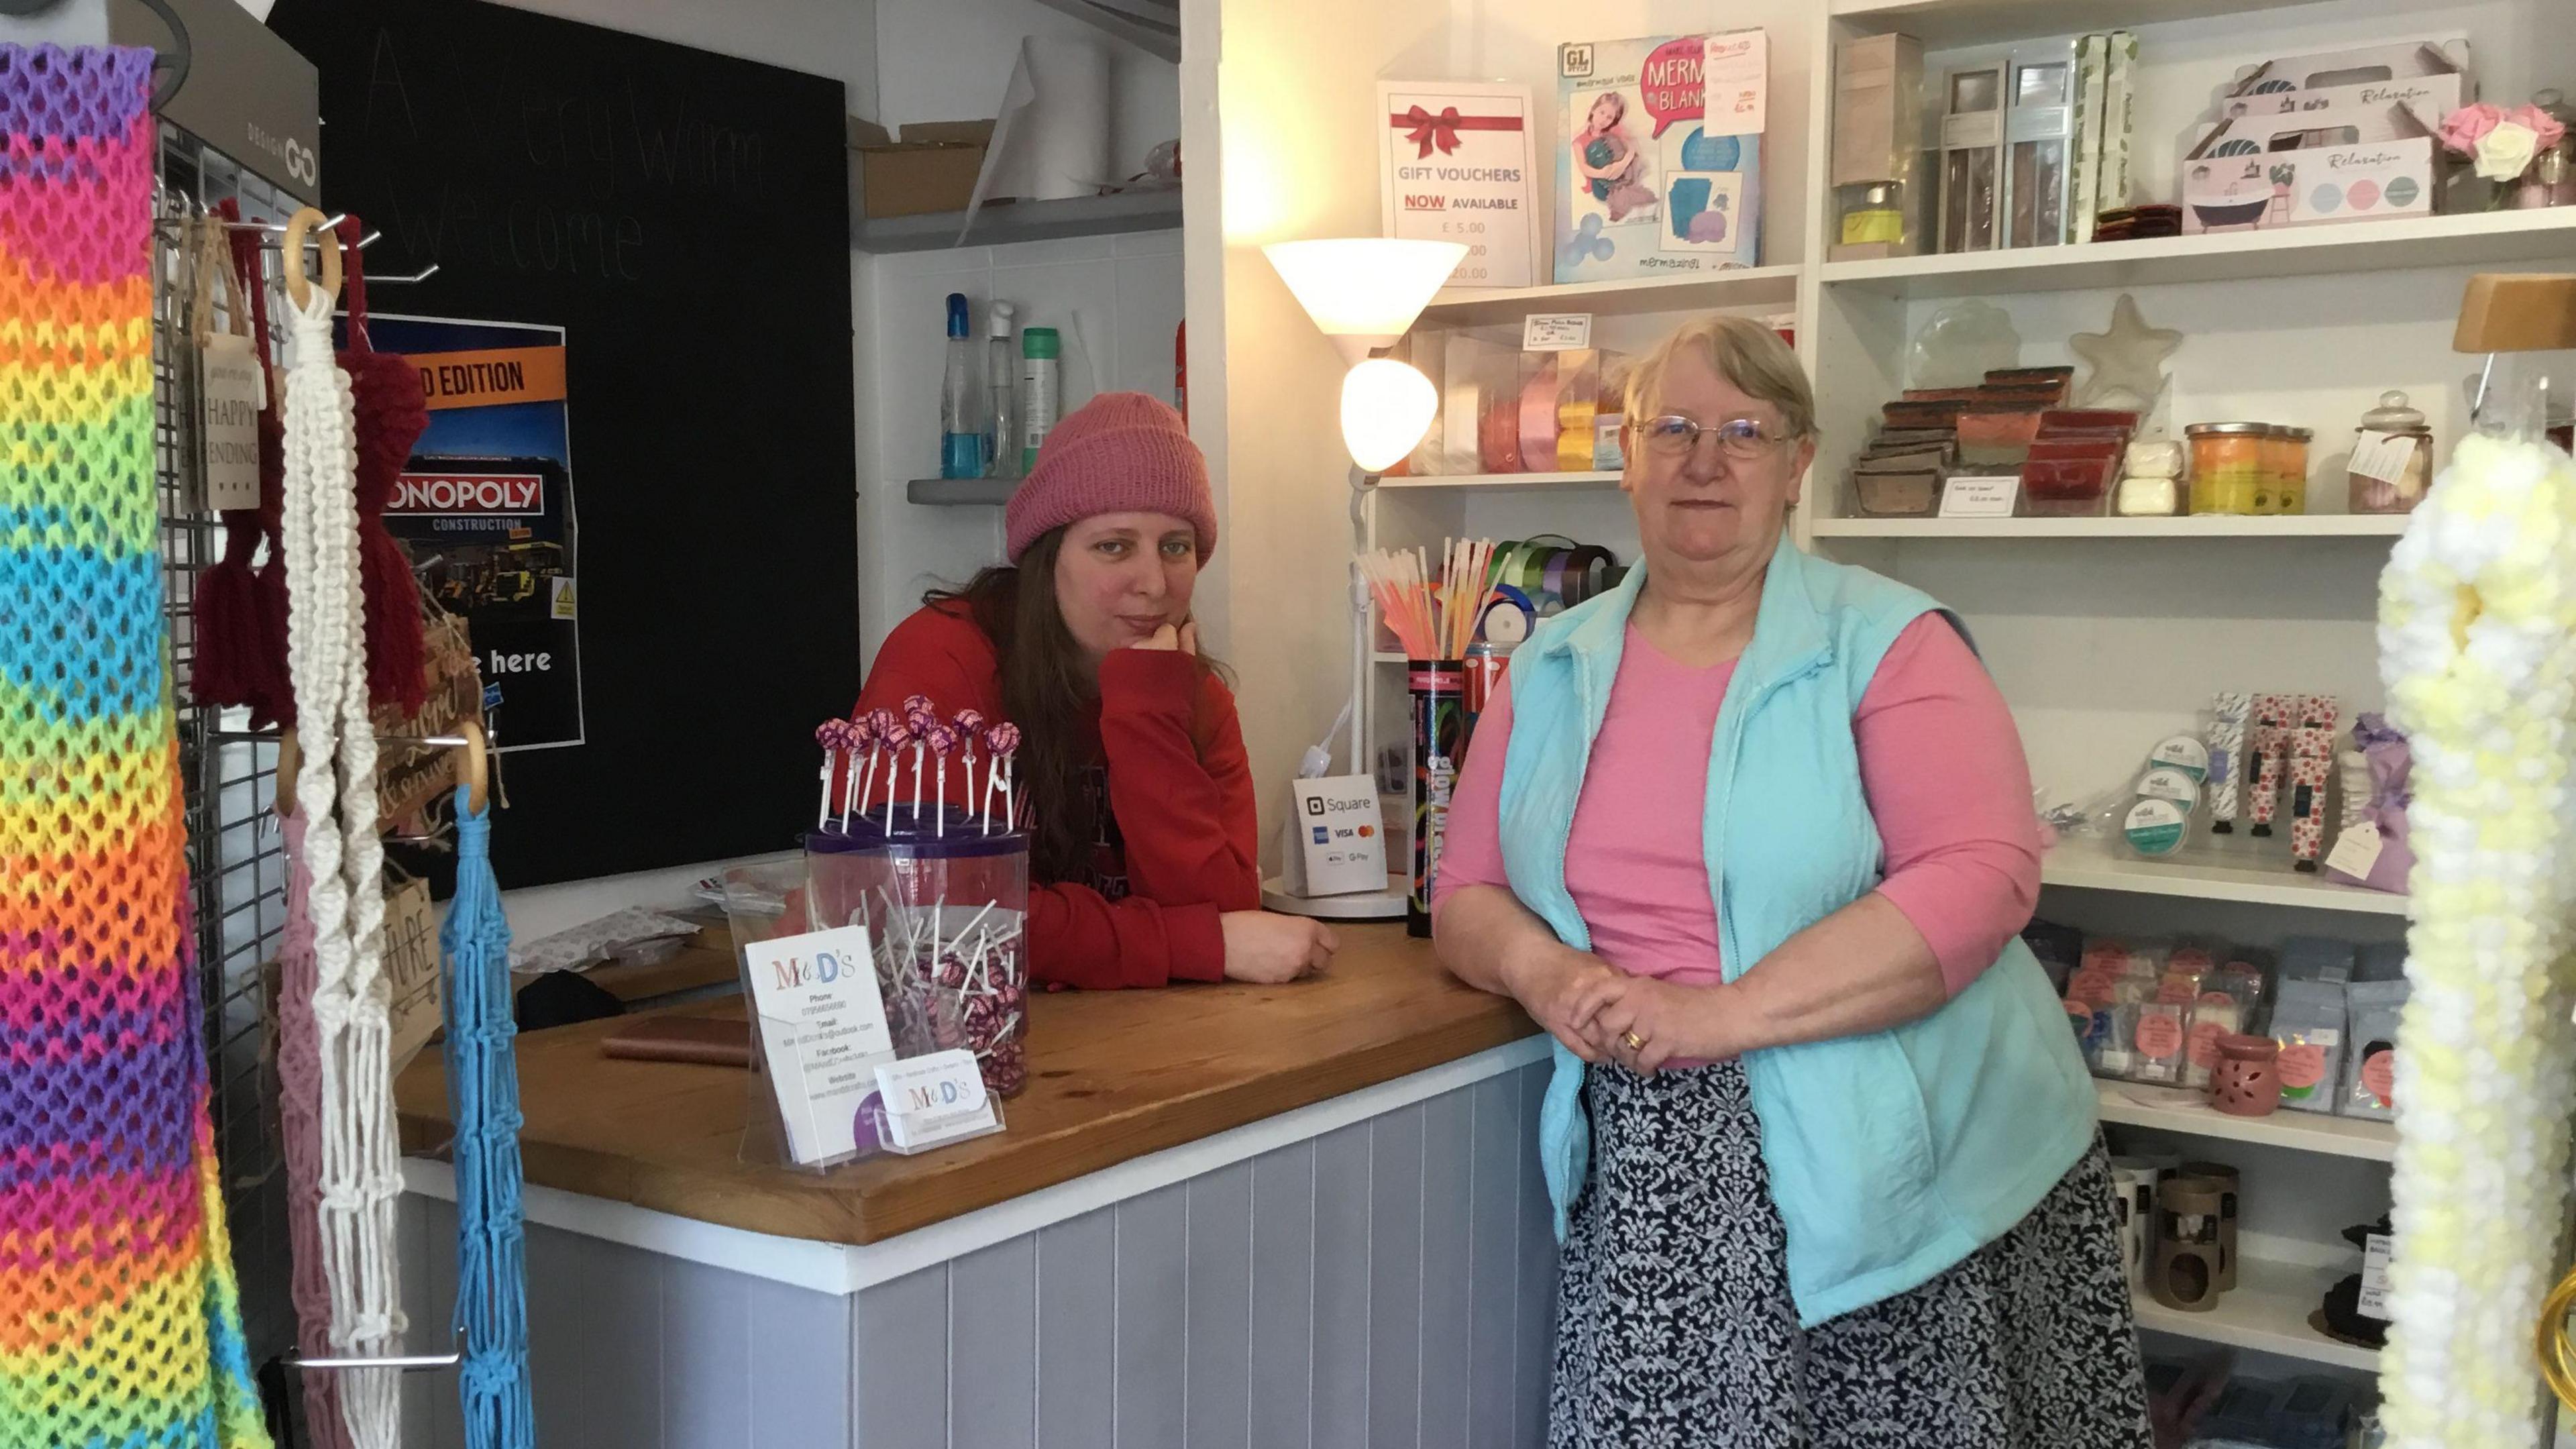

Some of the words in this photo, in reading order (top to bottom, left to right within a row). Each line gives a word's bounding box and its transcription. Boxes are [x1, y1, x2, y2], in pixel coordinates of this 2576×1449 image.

[1566, 50, 1589, 66] GL
[1648, 58, 1705, 87] MERM
[2360, 88, 2430, 104] Relaxation
[285, 138, 316, 187] GO
[2328, 152, 2402, 169] Relaxation
[1399, 166, 1433, 180] GIFT
[1436, 167, 1521, 182] VOUCHERS
[1405, 195, 1446, 211] NOW
[1452, 198, 1519, 210] AVAILABLE
[1456, 222, 1486, 234] 5.00
[439, 362, 525, 396] EDITION
[207, 398, 256, 427] HAPPY
[209, 441, 258, 464] ENDING
[386, 480, 537, 509] ONOPOLY
[433, 519, 522, 531] CONSTRUCTION
[491, 649, 551, 674] here
[1327, 798, 1371, 813] Square
[1334, 828, 1354, 838] VISA
